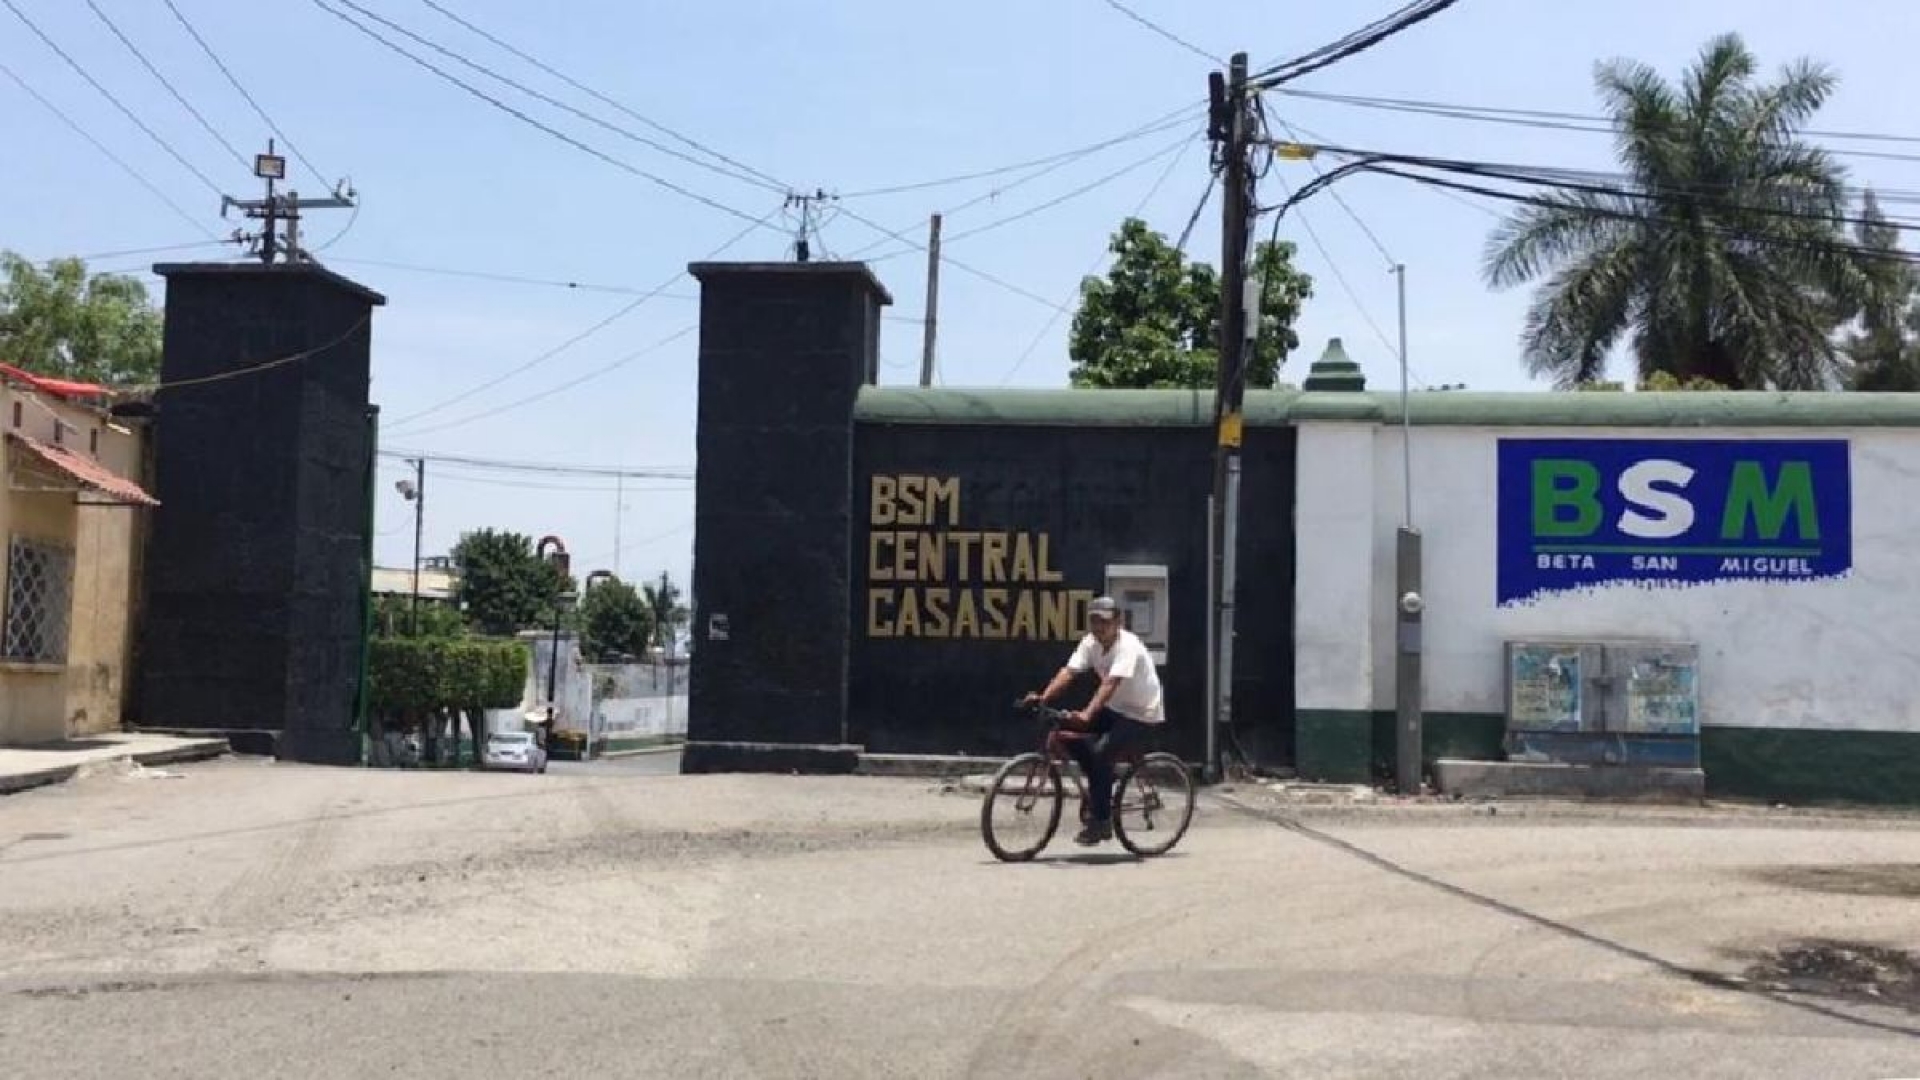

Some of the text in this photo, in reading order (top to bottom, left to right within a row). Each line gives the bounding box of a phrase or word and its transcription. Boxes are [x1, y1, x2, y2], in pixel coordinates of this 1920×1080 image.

[871, 474, 960, 525] BSM
[1530, 458, 1820, 540] BSM
[869, 531, 1063, 581] CENTRAL
[1536, 554, 1813, 575] BETA SAN MIGUEL
